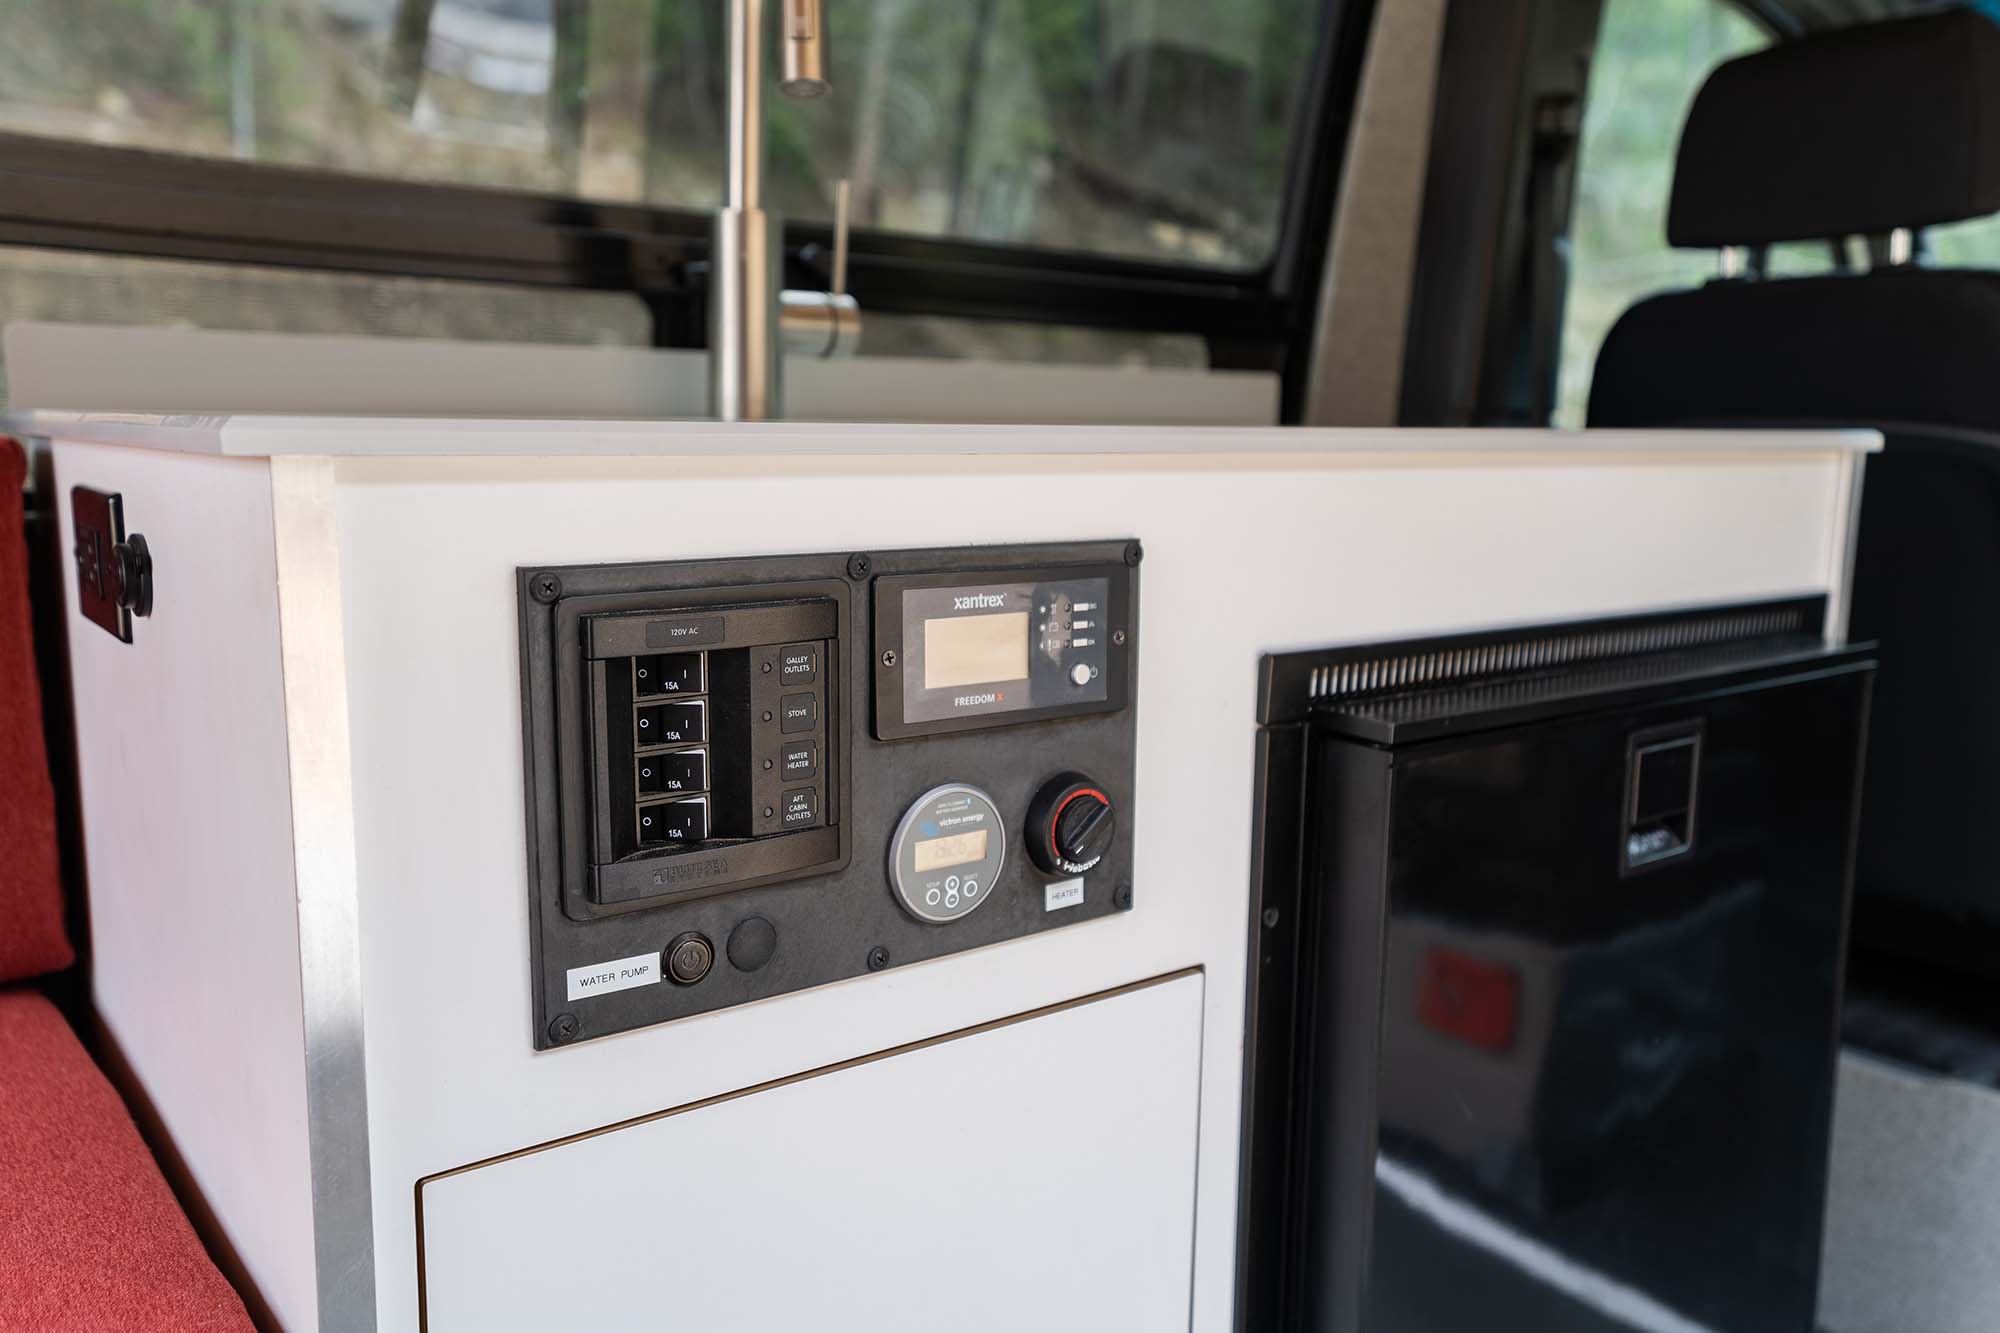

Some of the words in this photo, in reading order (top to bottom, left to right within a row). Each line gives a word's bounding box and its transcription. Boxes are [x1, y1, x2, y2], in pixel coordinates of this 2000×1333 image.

[953, 593, 1005, 610] xantrex
[671, 628, 687, 636] 120V
[688, 627, 699, 635] AC
[786, 656, 808, 665] GALLEY
[784, 664, 810, 674] OUTLETS
[664, 681, 679, 690] 15A
[954, 693, 996, 707] FREEDOM
[788, 708, 807, 718] STOVE
[666, 731, 681, 740] 15A
[788, 751, 809, 761] WATER
[787, 760, 809, 770] HEATER
[667, 780, 682, 789] 15A
[792, 794, 804, 803] AFT
[788, 803, 808, 813] CABIN
[785, 811, 812, 822] OUTLETS
[962, 814, 985, 823] energy
[668, 829, 683, 838] 15A
[1051, 888, 1080, 900] HEATER
[580, 972, 616, 987] WATER
[621, 965, 649, 979] PUMP
